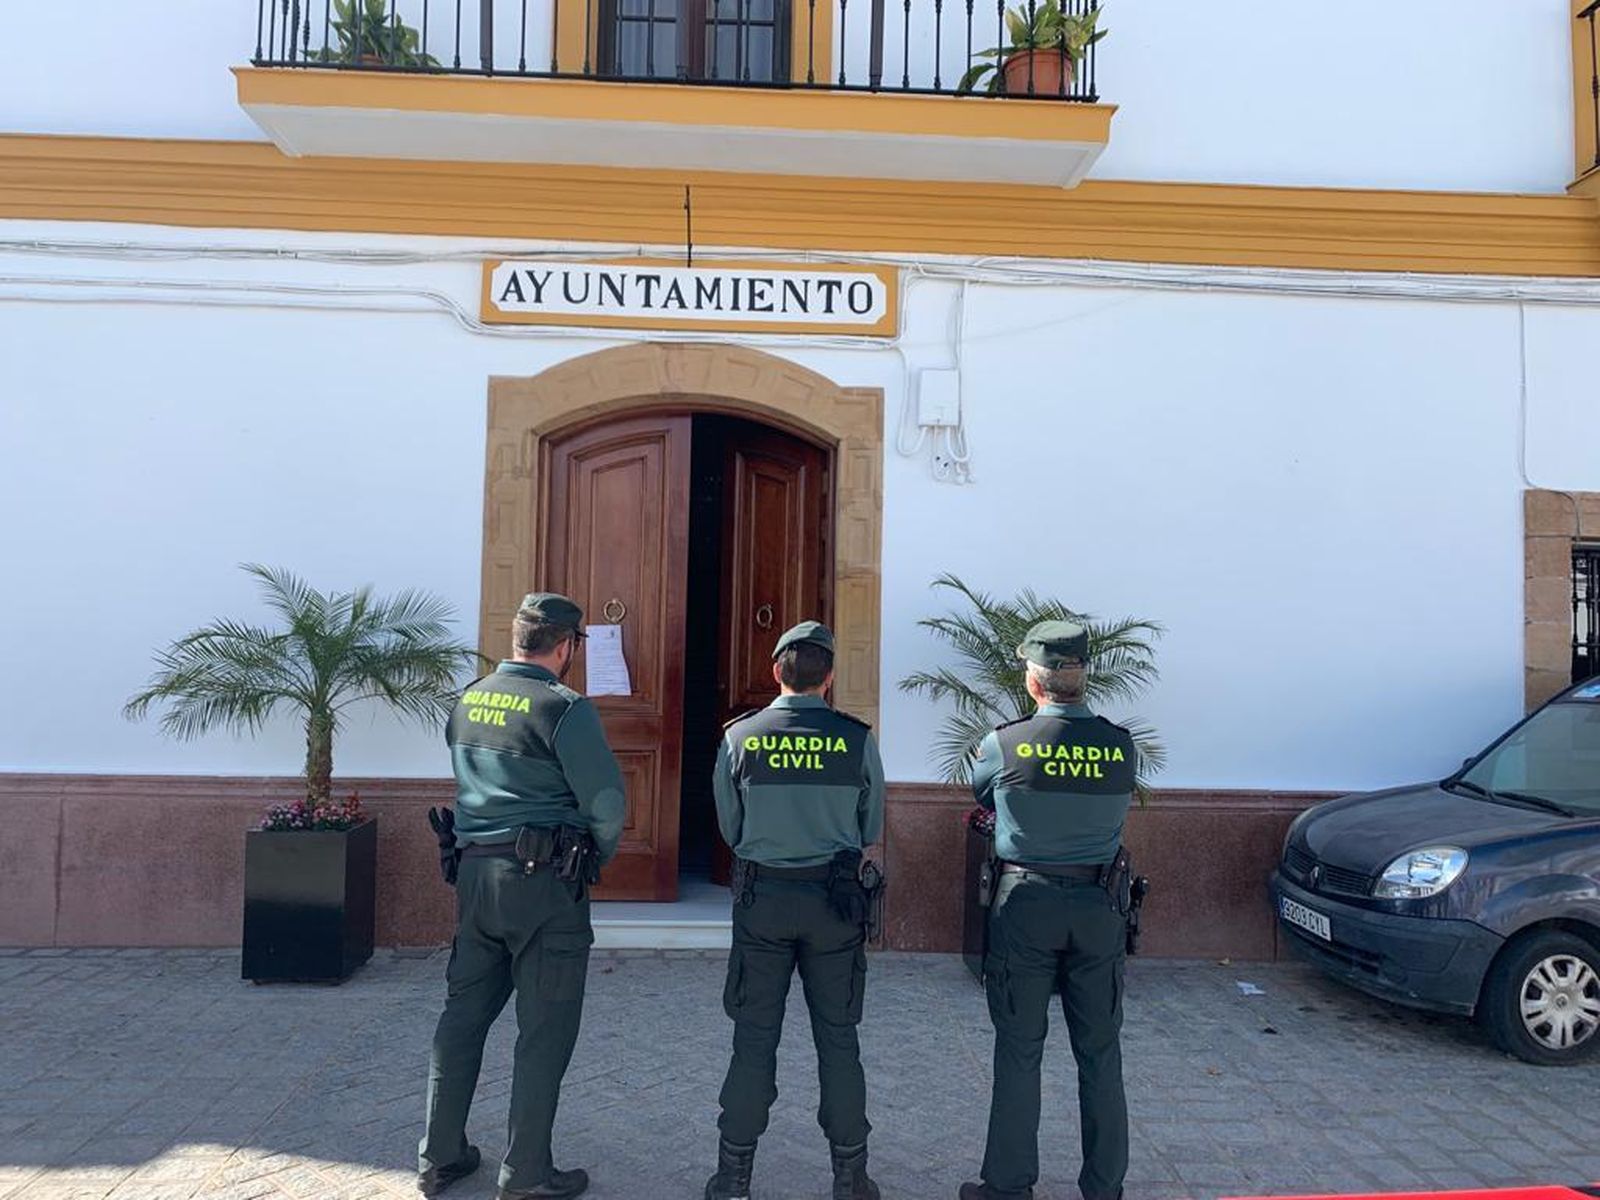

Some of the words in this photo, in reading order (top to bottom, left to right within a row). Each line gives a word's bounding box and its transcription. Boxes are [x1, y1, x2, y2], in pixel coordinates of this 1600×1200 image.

[500, 270, 874, 314] AYUNTAMIENTO
[462, 691, 531, 713] GUARDIA
[468, 707, 507, 727] CIVIL
[744, 735, 848, 753] GUARDIA
[1016, 742, 1125, 762] GUARDIA
[768, 753, 825, 769] CIVIL
[1044, 761, 1104, 778] CIVIL
